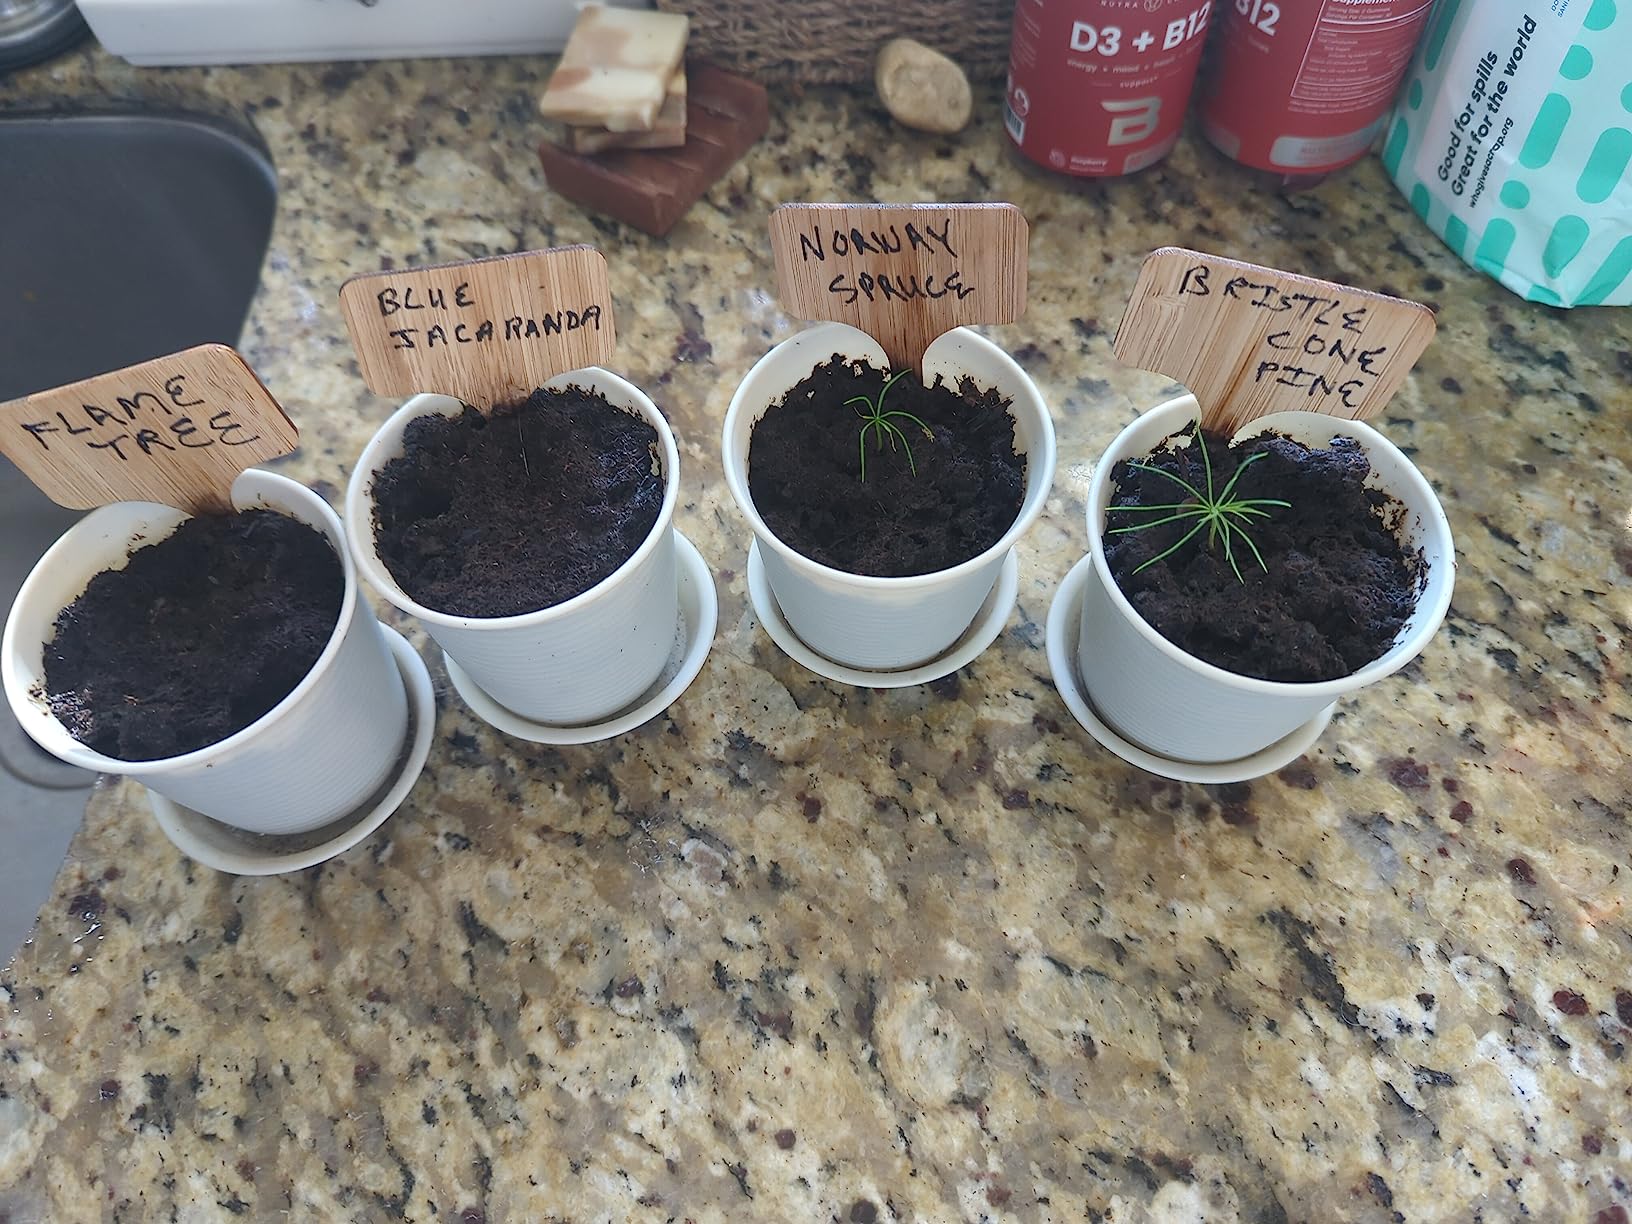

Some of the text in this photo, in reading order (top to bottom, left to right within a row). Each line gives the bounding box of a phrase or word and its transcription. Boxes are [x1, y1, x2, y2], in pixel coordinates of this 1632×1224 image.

[1069, 21, 1122, 57] D3
[1132, 31, 1155, 53] +
[1162, 1, 1212, 51] B12
[1558, 0, 1570, 17] SANI
[1438, 51, 1498, 181] Good for spills
[1451, 13, 1537, 196] Great for the world
[1469, 117, 1514, 208] whogivesacrap.org
[799, 218, 958, 262] NORWAY
[377, 282, 475, 317] BLUE
[828, 271, 975, 305] SPRUCE
[1178, 265, 1367, 334] BRISTLE
[390, 304, 601, 350] JACARANDA
[1267, 331, 1387, 378] CONE
[1255, 361, 1364, 408] PINE
[21, 374, 204, 450] FLAME
[88, 411, 260, 461] TREE
